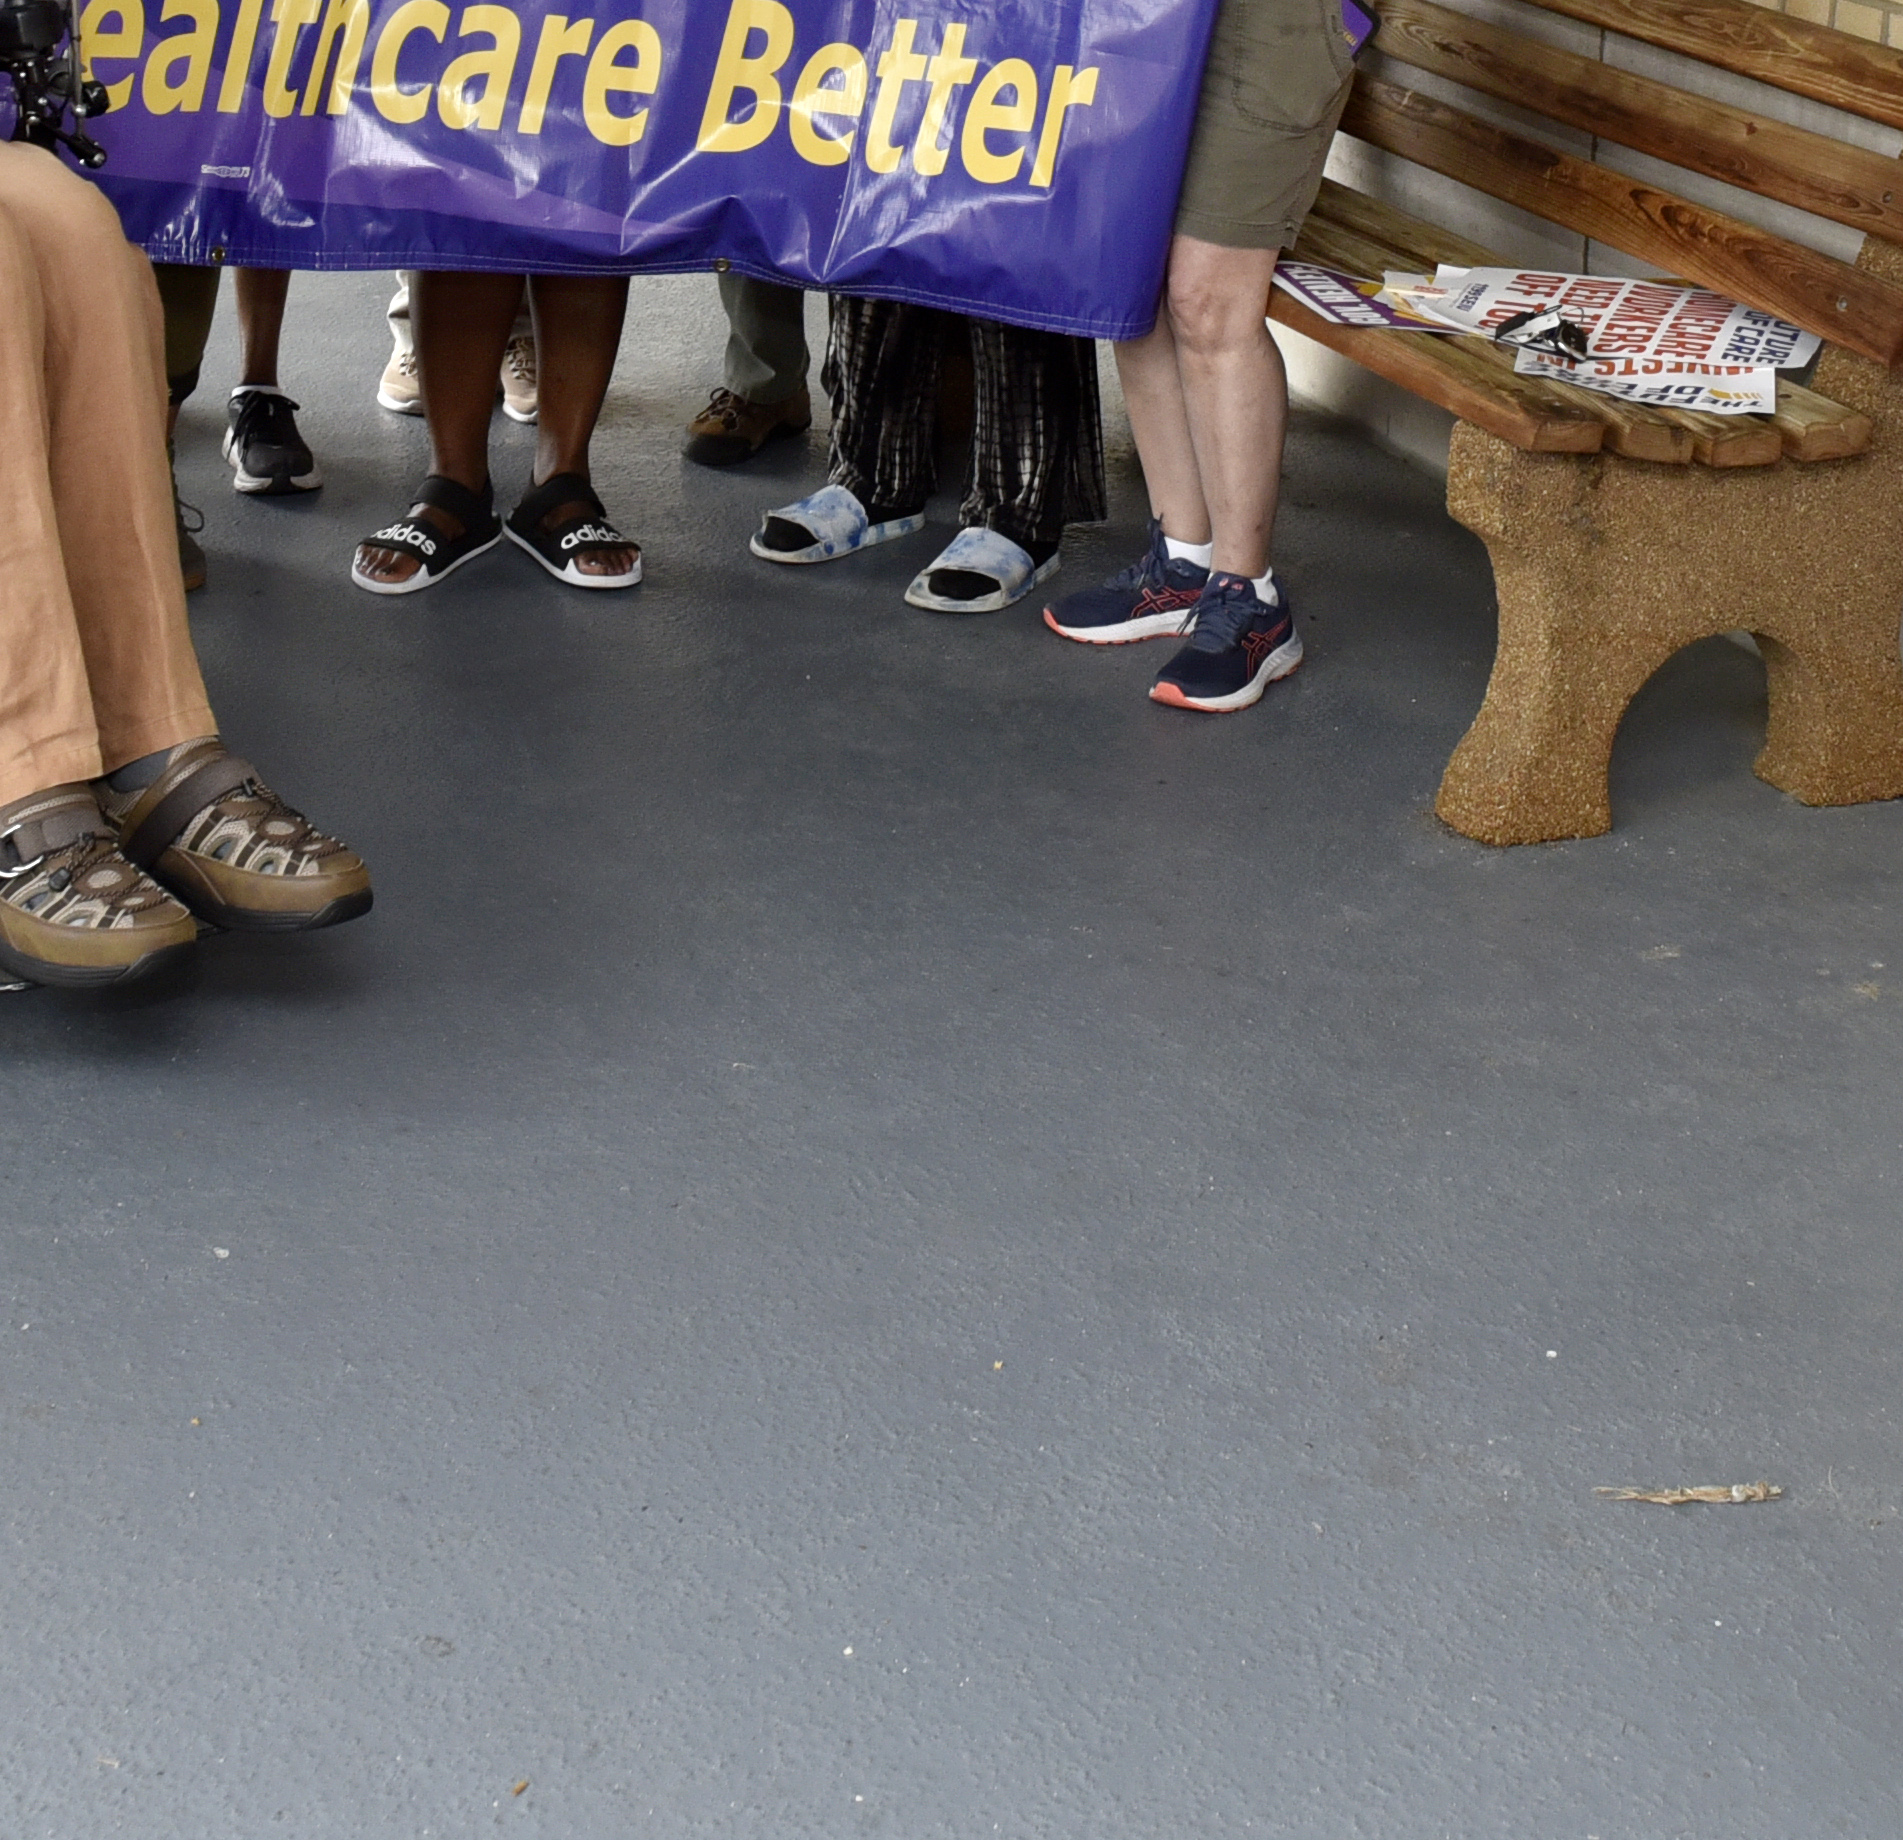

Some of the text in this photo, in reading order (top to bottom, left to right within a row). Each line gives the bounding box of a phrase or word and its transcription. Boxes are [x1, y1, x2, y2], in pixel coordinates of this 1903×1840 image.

[1504, 273, 1568, 298] OFF
[1558, 278, 1626, 309] NEED
[1592, 283, 1686, 354] WORKERS
[1721, 325, 1766, 364] CARE
[1755, 319, 1802, 366] UTURE
